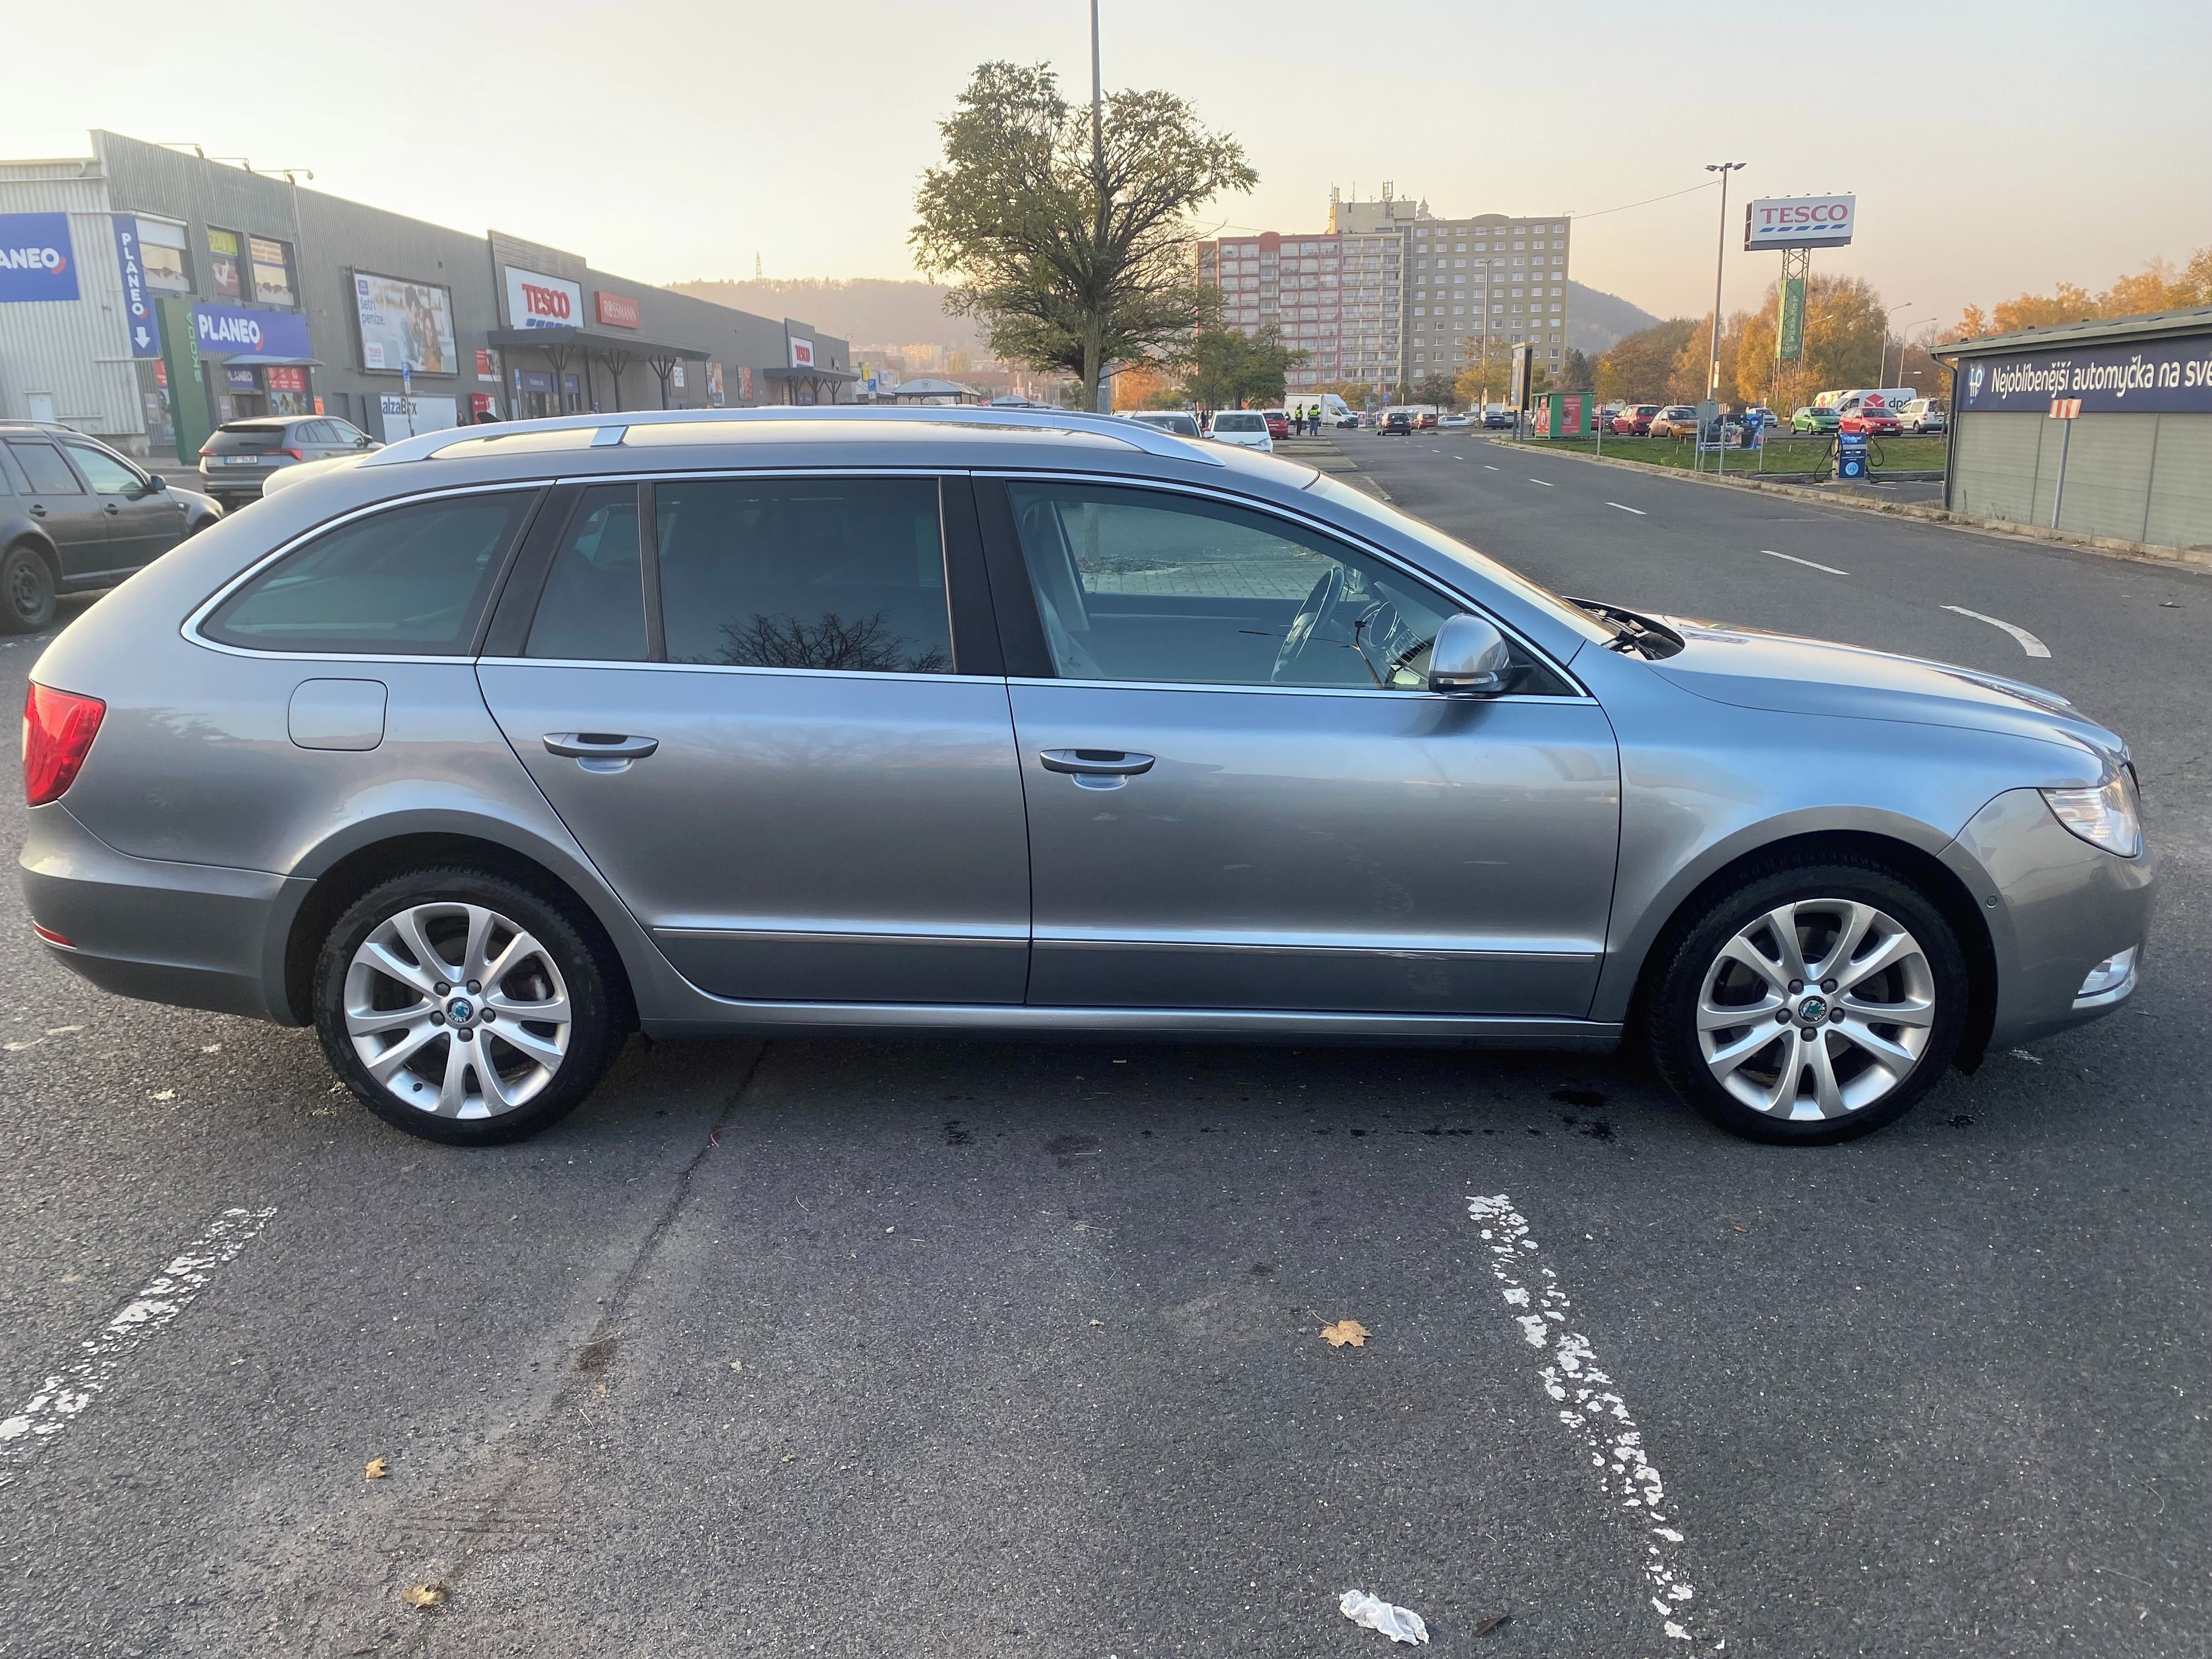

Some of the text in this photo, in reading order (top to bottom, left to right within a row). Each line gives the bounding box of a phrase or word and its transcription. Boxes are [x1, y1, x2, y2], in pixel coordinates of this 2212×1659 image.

[1759, 204, 1848, 224] TESCO
[121, 233, 144, 315] PLANEO
[522, 283, 570, 319] TESCO
[603, 300, 636, 321] ROSSMANN
[198, 314, 260, 343] PLANEO
[795, 345, 810, 363] TESCO
[1991, 360, 2072, 399] Nejoblíbenější
[2073, 354, 2155, 398] automyčka
[2158, 361, 2181, 387] na
